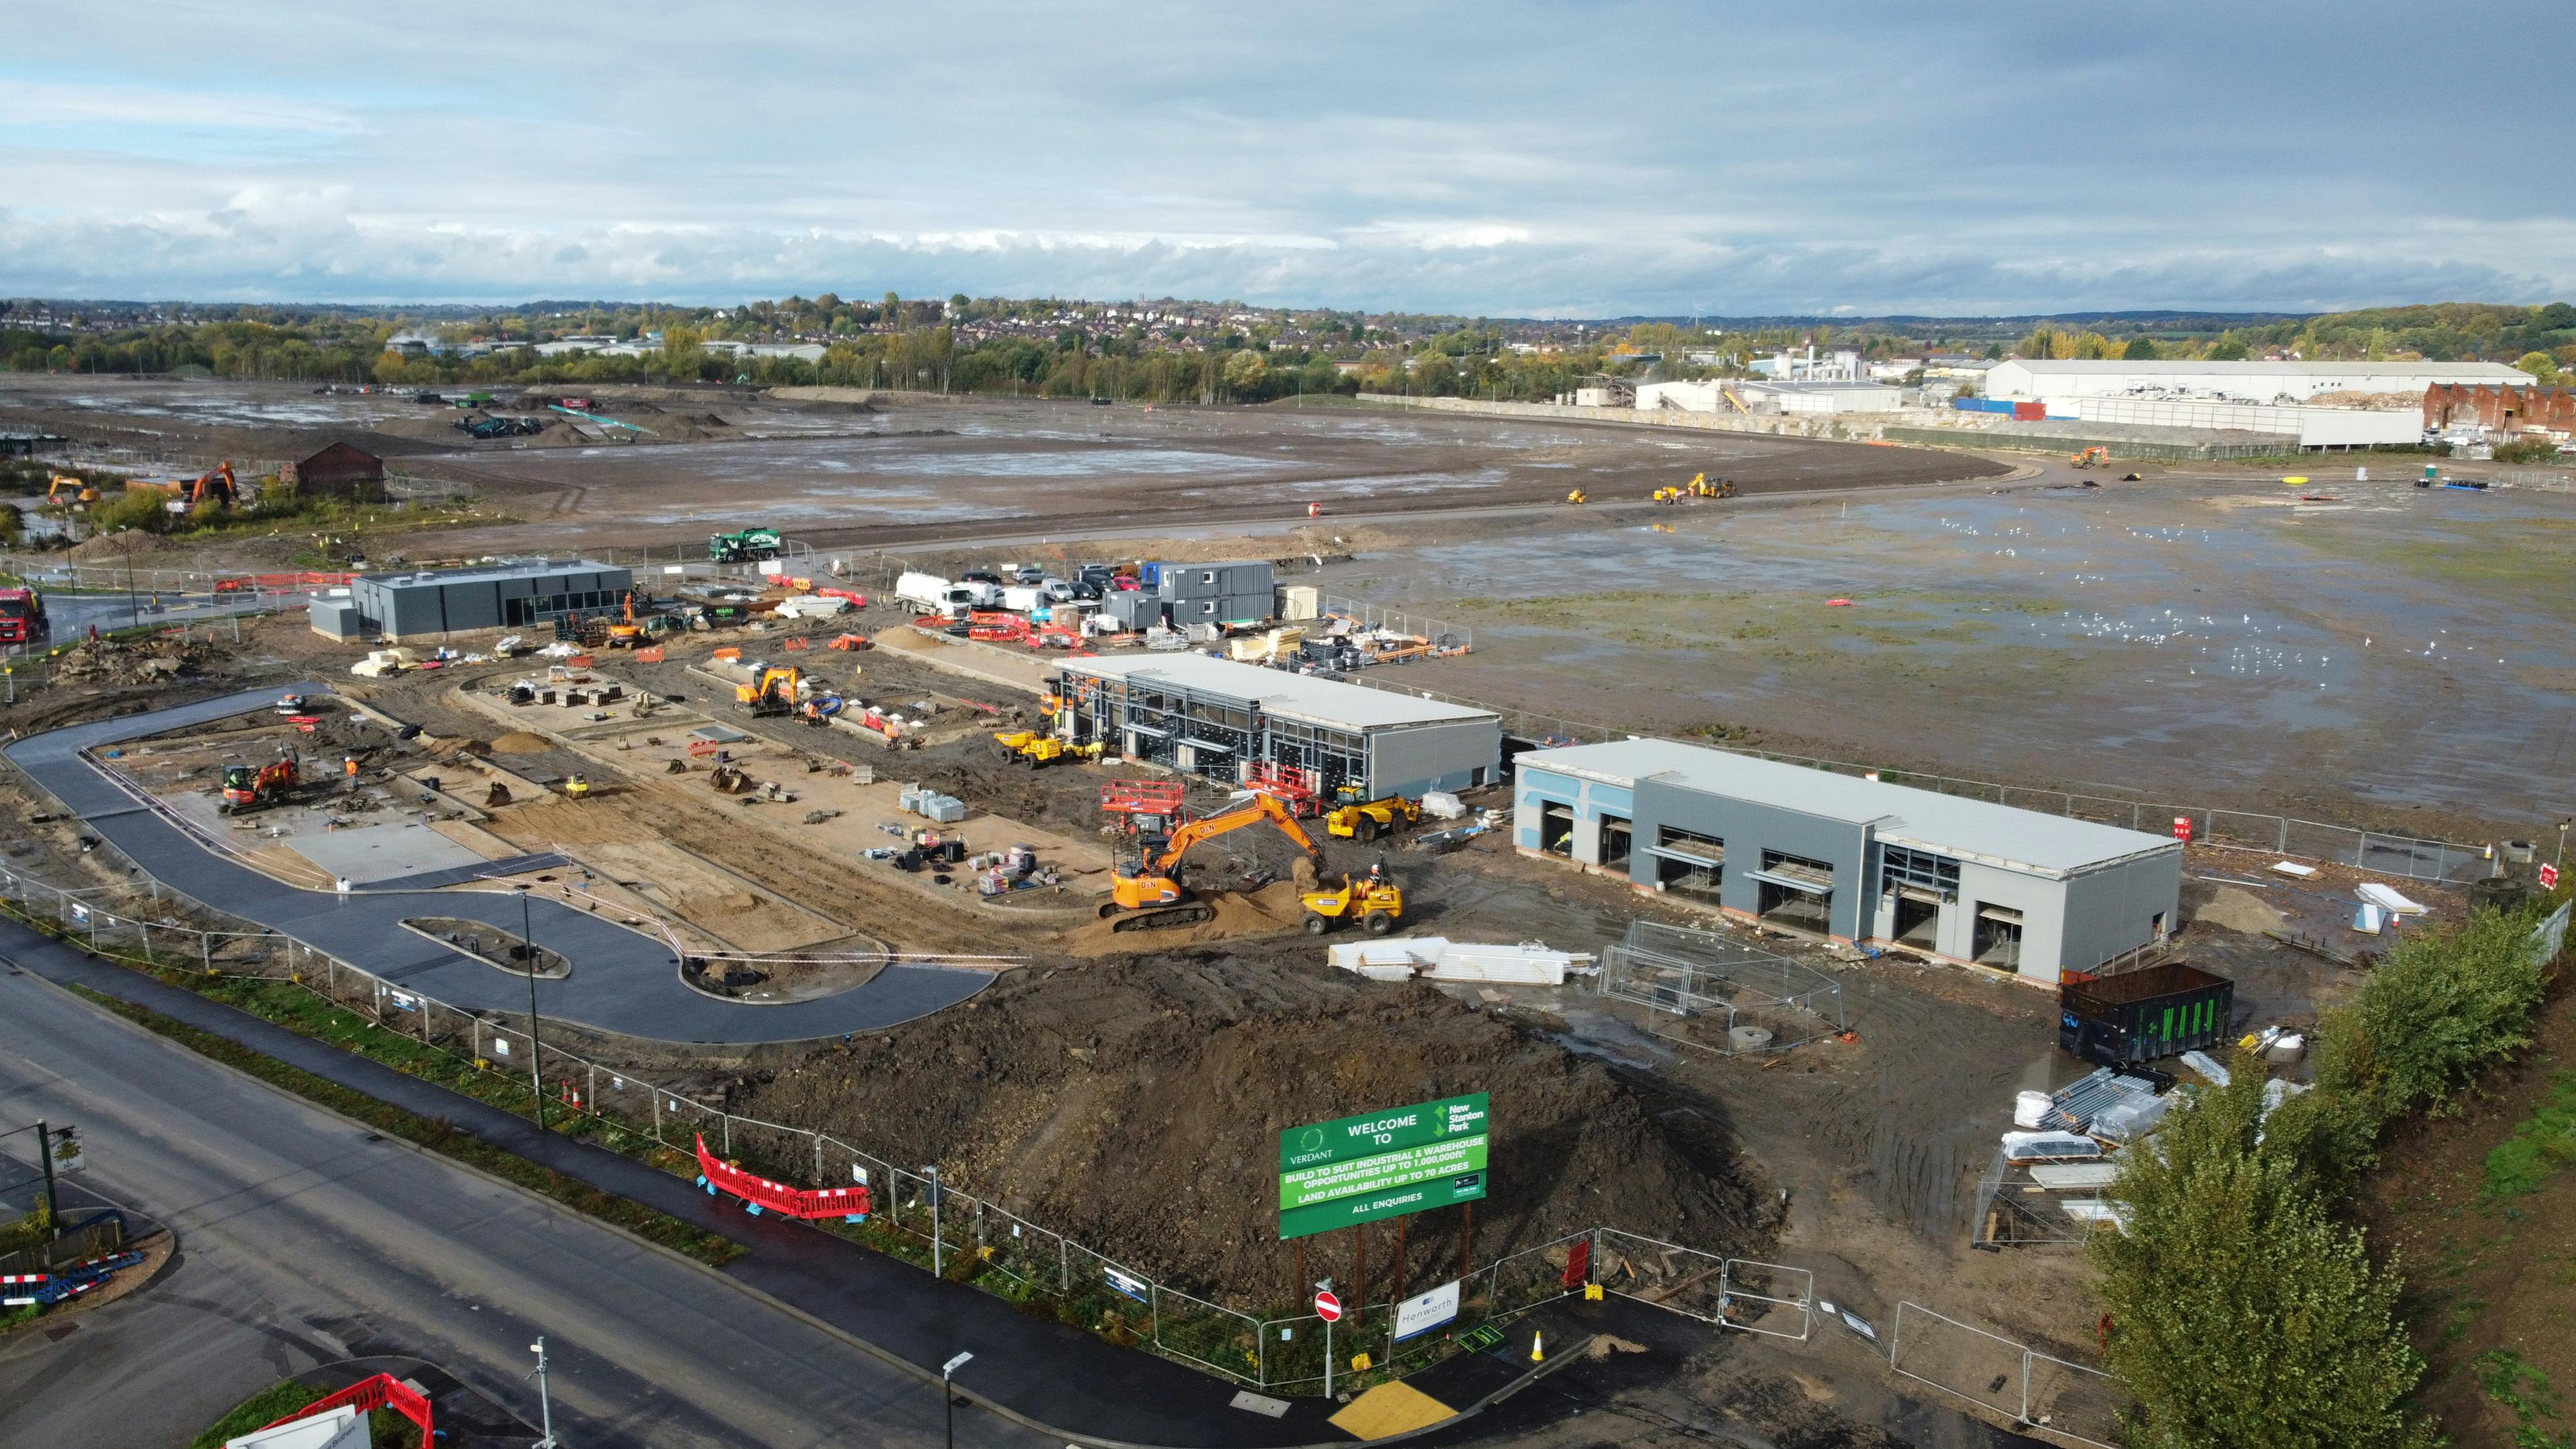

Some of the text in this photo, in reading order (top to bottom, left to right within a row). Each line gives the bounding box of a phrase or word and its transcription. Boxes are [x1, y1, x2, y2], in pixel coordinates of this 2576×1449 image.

[1449, 1104, 1470, 1115] New
[1449, 1111, 1484, 1123] Stanton
[1348, 1114, 1417, 1137] WELCOME
[1448, 1121, 1469, 1133] Park
[1372, 1133, 1392, 1145] TO
[1285, 1137, 1484, 1184] BUILD TO SUIT INDUSTRIAL & WAREHOUSE
[1290, 1149, 1333, 1165] VERDANT
[1298, 1162, 1469, 1204] LAND AVAILABILITY UP TO 70 ACRES
[1303, 1167, 1381, 1189] OPPORTUNITIES
[1383, 1164, 1396, 1173] UP
[1398, 1161, 1412, 1170] TO
[1352, 1192, 1423, 1214] ALL ENQUIRIES
[1402, 1298, 1452, 1323] Henworth
